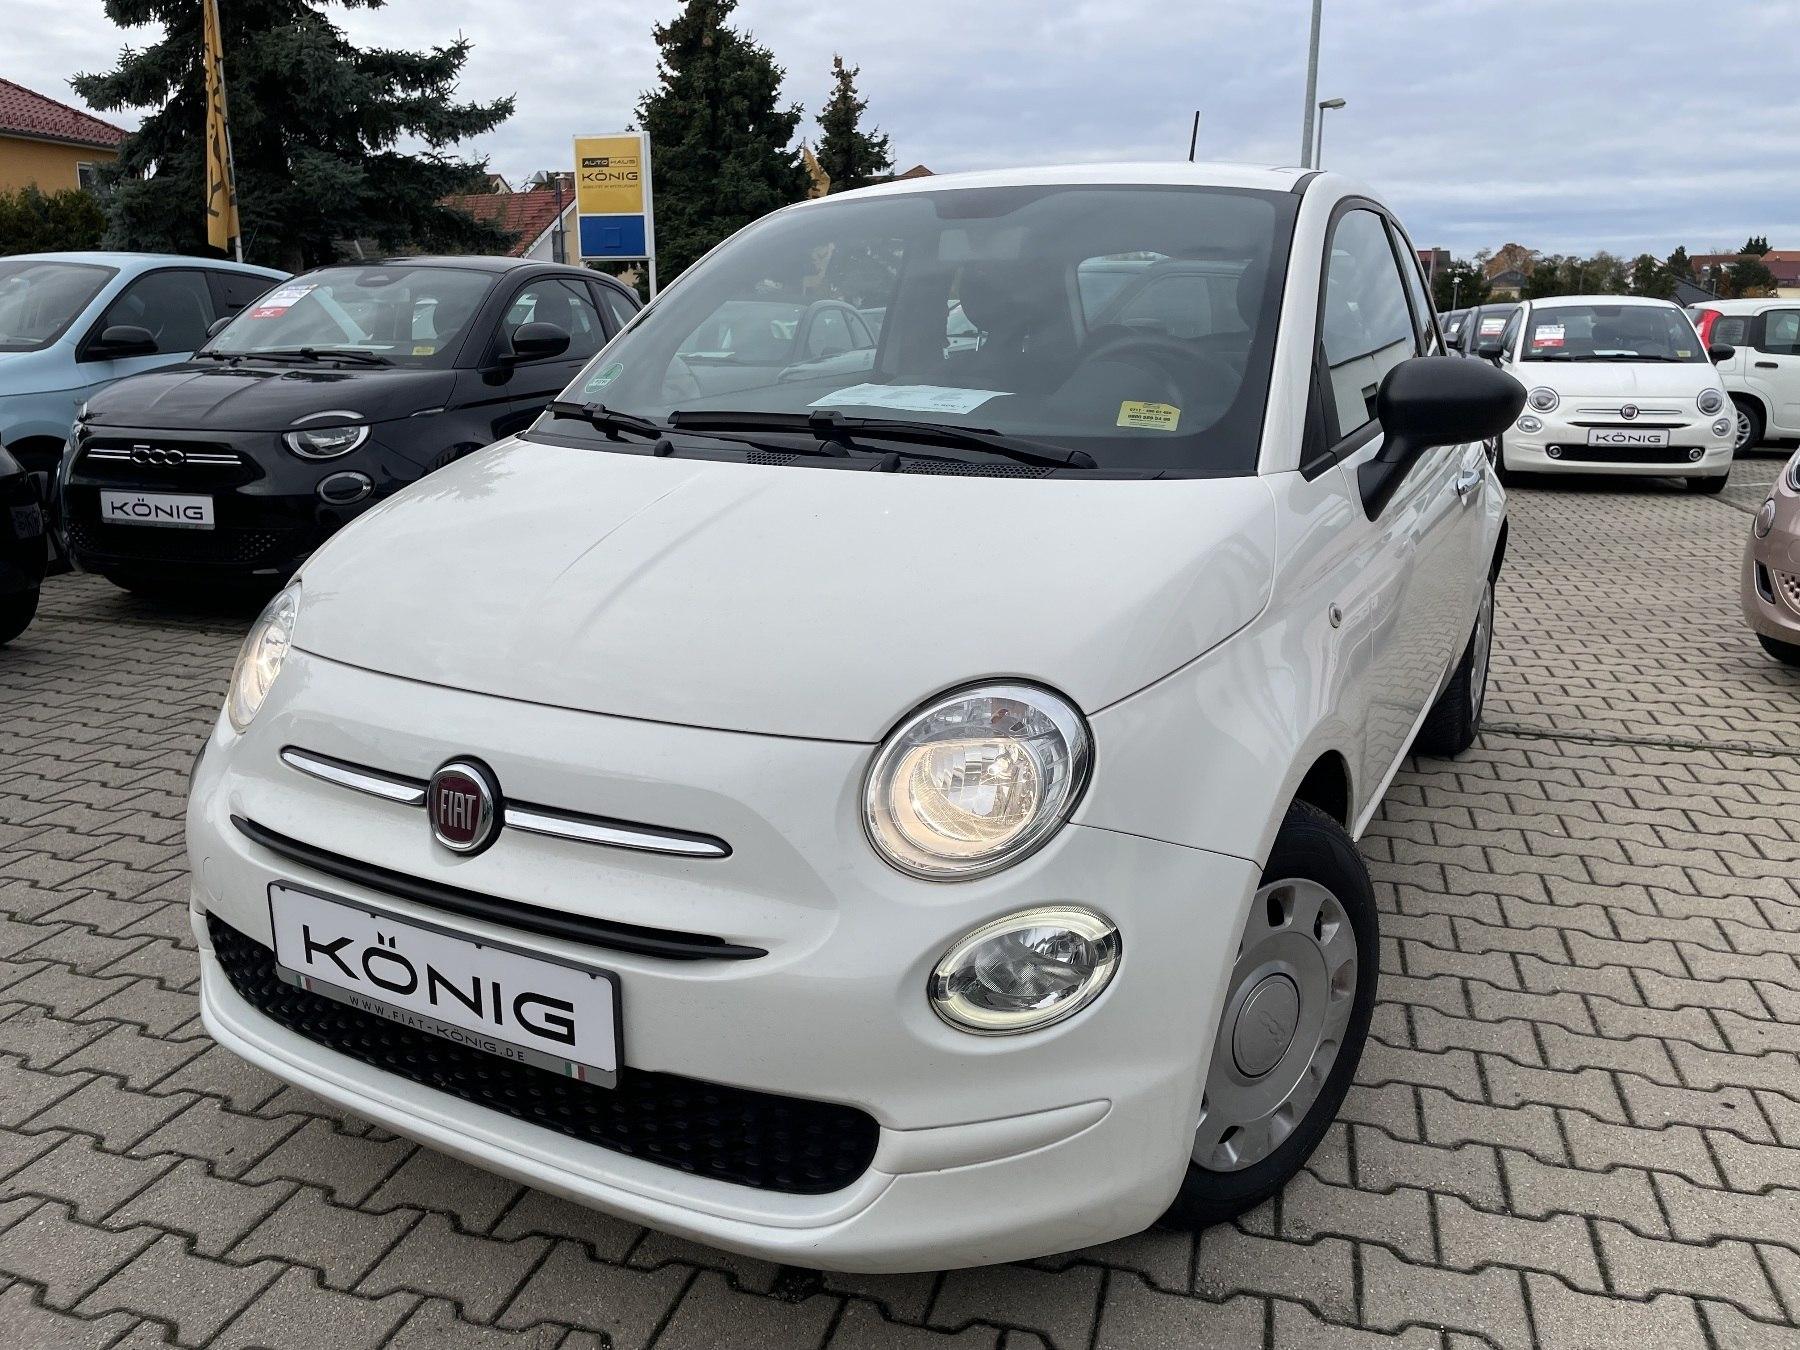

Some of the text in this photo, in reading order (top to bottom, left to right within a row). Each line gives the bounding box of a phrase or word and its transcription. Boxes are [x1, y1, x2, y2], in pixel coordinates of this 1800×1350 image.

[582, 170, 637, 181] KÖNIG
[1595, 431, 1662, 443] KÖNIG
[131, 444, 185, 464] 500
[110, 497, 204, 521] KÖNIG
[440, 788, 477, 831] FIAT
[302, 924, 576, 1047] KÖNIG
[348, 995, 527, 1062] WWW.FIAT-KÖNIG.DE
